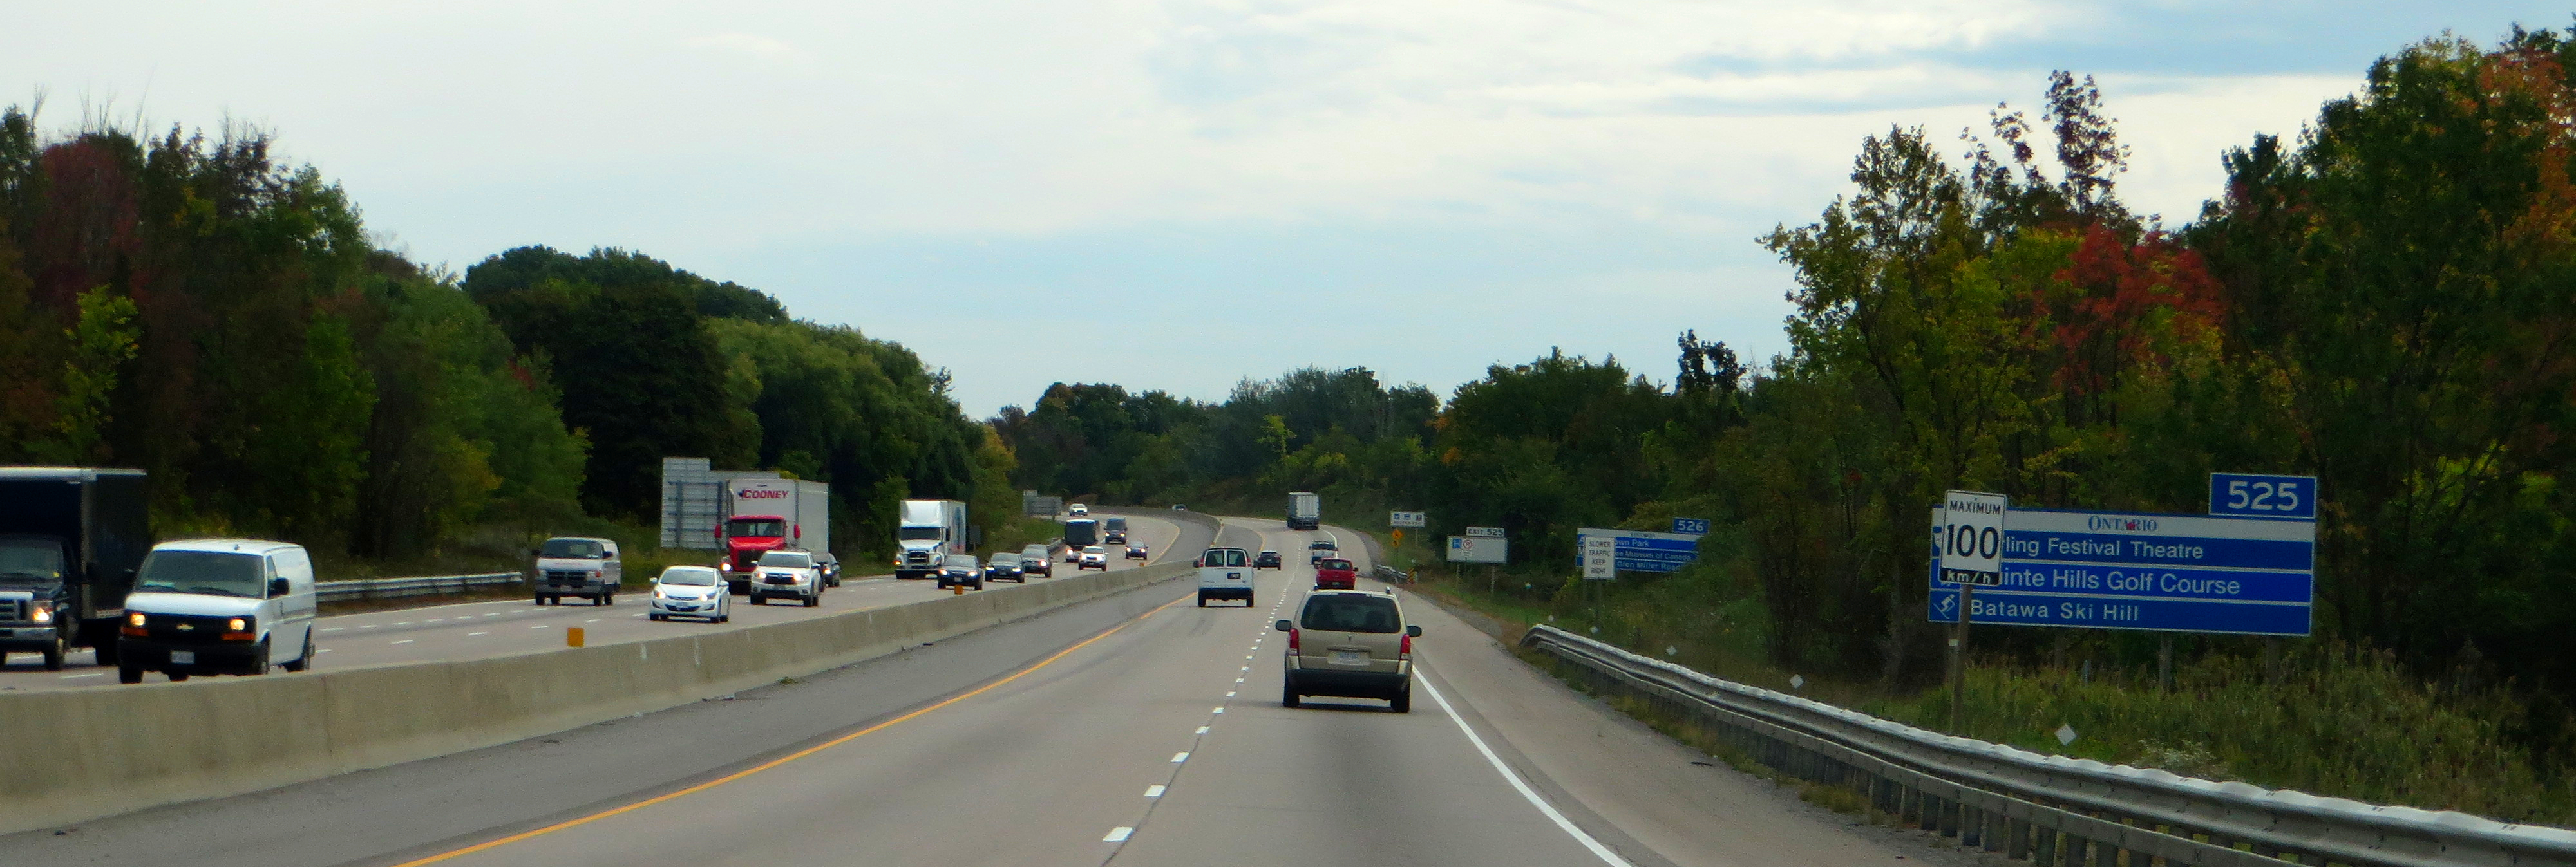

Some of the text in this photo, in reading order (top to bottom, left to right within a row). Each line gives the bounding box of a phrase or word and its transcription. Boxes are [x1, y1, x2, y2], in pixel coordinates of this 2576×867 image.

[743, 489, 789, 499] COONEY
[2228, 480, 2298, 511] 525
[1949, 499, 2001, 515] MAXIMUM
[1678, 519, 1703, 532] 526
[2088, 515, 2158, 532] ONTARIO
[1632, 539, 1649, 547] Park
[1947, 524, 1999, 559] 100
[2048, 537, 2121, 556] Festival
[2130, 541, 2204, 559] Theatre
[1625, 550, 1654, 559] Museum
[1665, 552, 1691, 561] Canada
[1946, 570, 1991, 584] km/h
[2053, 568, 2099, 590] Hills
[2107, 570, 2154, 592] Golf
[2160, 573, 2240, 595] Course
[1971, 599, 2139, 621] Batawa Ski Hill
